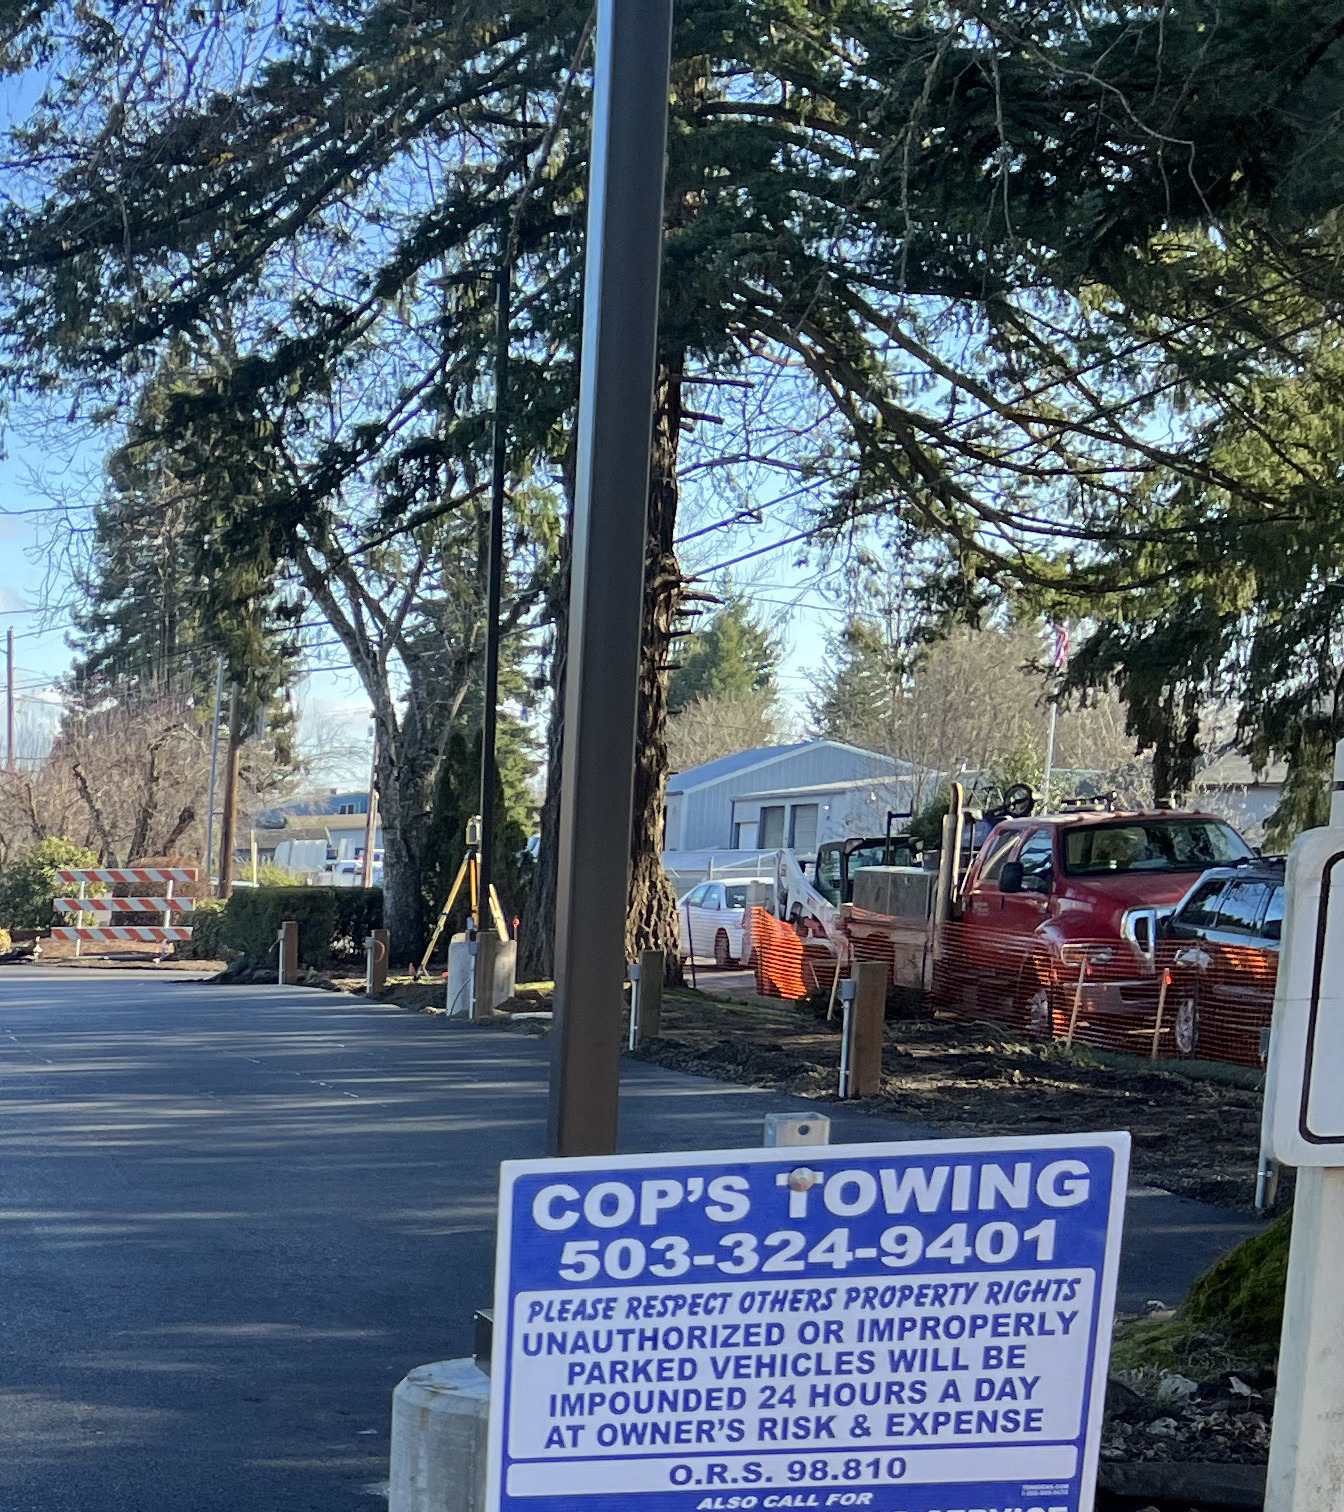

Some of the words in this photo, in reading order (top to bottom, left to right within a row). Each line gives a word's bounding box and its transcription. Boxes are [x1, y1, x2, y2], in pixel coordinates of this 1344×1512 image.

[533, 1176, 750, 1230] COP'S
[776, 1160, 1090, 1218] TOWING
[559, 1219, 1056, 1281] 503-324-9401
[528, 1297, 618, 1323] PLEASE
[625, 1293, 732, 1320] RESPECT
[739, 1288, 837, 1314] OTHERS
[844, 1282, 979, 1310] PROPERTY
[985, 1278, 1081, 1306] RIGHTS
[523, 1323, 784, 1356] UNAUTHORIZED
[798, 1320, 844, 1345] OR
[857, 1311, 1078, 1342] IMPROPERLY
[568, 1358, 697, 1385] PARKED
[710, 1350, 875, 1379] VEHICLES
[888, 1347, 969, 1373] WILL
[983, 1345, 1026, 1369] BE
[550, 1387, 746, 1417] IMPOUNDED
[758, 1385, 796, 1409] 24
[809, 1380, 926, 1407] HOURS
[939, 1379, 961, 1403] A
[974, 1376, 1041, 1401] DAY
[545, 1425, 585, 1449] AT
[597, 1419, 744, 1446] OWNER'S
[758, 1416, 836, 1441] RISK
[850, 1414, 871, 1438] &
[886, 1408, 1043, 1436] EXPENSE
[670, 1462, 772, 1485] O.R.S.
[788, 1457, 906, 1481] 98.810
[697, 1496, 758, 1510] ALSO
[763, 1494, 819, 1507] CALL
[826, 1493, 873, 1505] FOR
